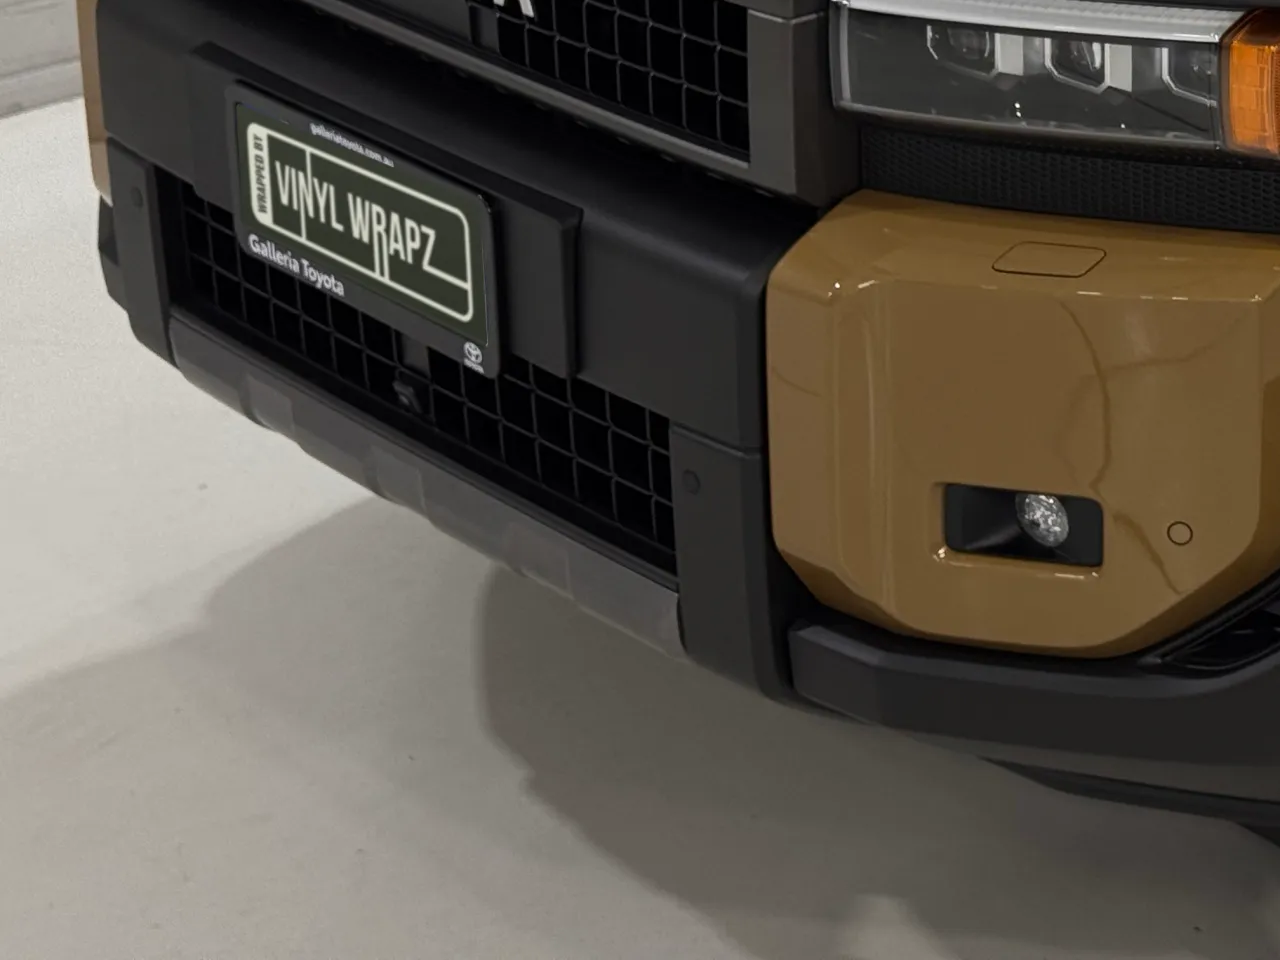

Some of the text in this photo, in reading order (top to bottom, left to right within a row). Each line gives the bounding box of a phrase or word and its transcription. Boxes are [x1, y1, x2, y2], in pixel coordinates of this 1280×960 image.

[252, 133, 269, 215] WRAPPED BY
[274, 150, 455, 283] VINYL WRAPZ
[248, 233, 346, 297] Galleria Toyota
